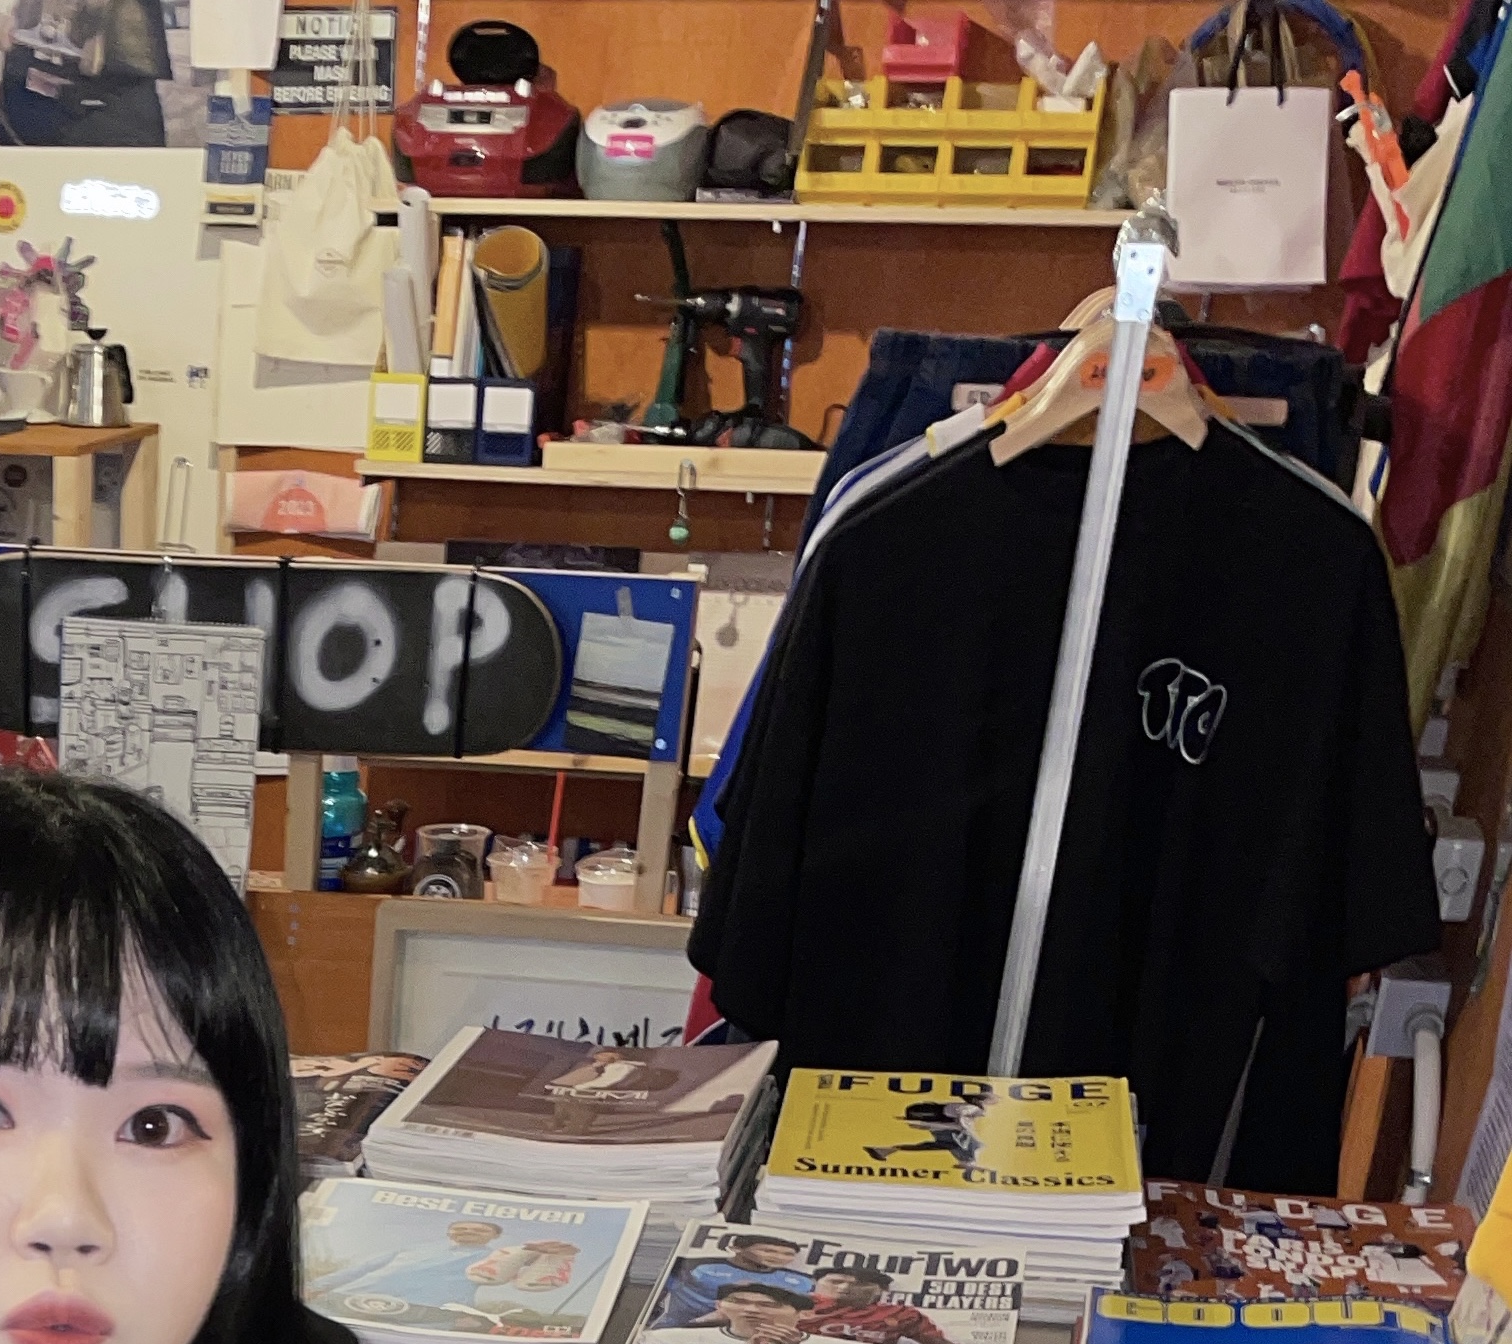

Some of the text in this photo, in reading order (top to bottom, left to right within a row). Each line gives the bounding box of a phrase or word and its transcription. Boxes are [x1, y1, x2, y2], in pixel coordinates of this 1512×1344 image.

[295, 15, 364, 36] NOTIC
[289, 44, 340, 62] PLEASE
[313, 65, 352, 82] MAS
[273, 85, 393, 103] BEFORE ENERING
[838, 1074, 1111, 1102] FUDGE
[794, 1156, 1116, 1188] Summer Classics
[370, 1190, 587, 1226] Best Eleven
[1147, 1182, 1454, 1230] FUDGE
[690, 1224, 1021, 1278] FoFourTwo
[921, 1294, 1014, 1310] PLAYERS
